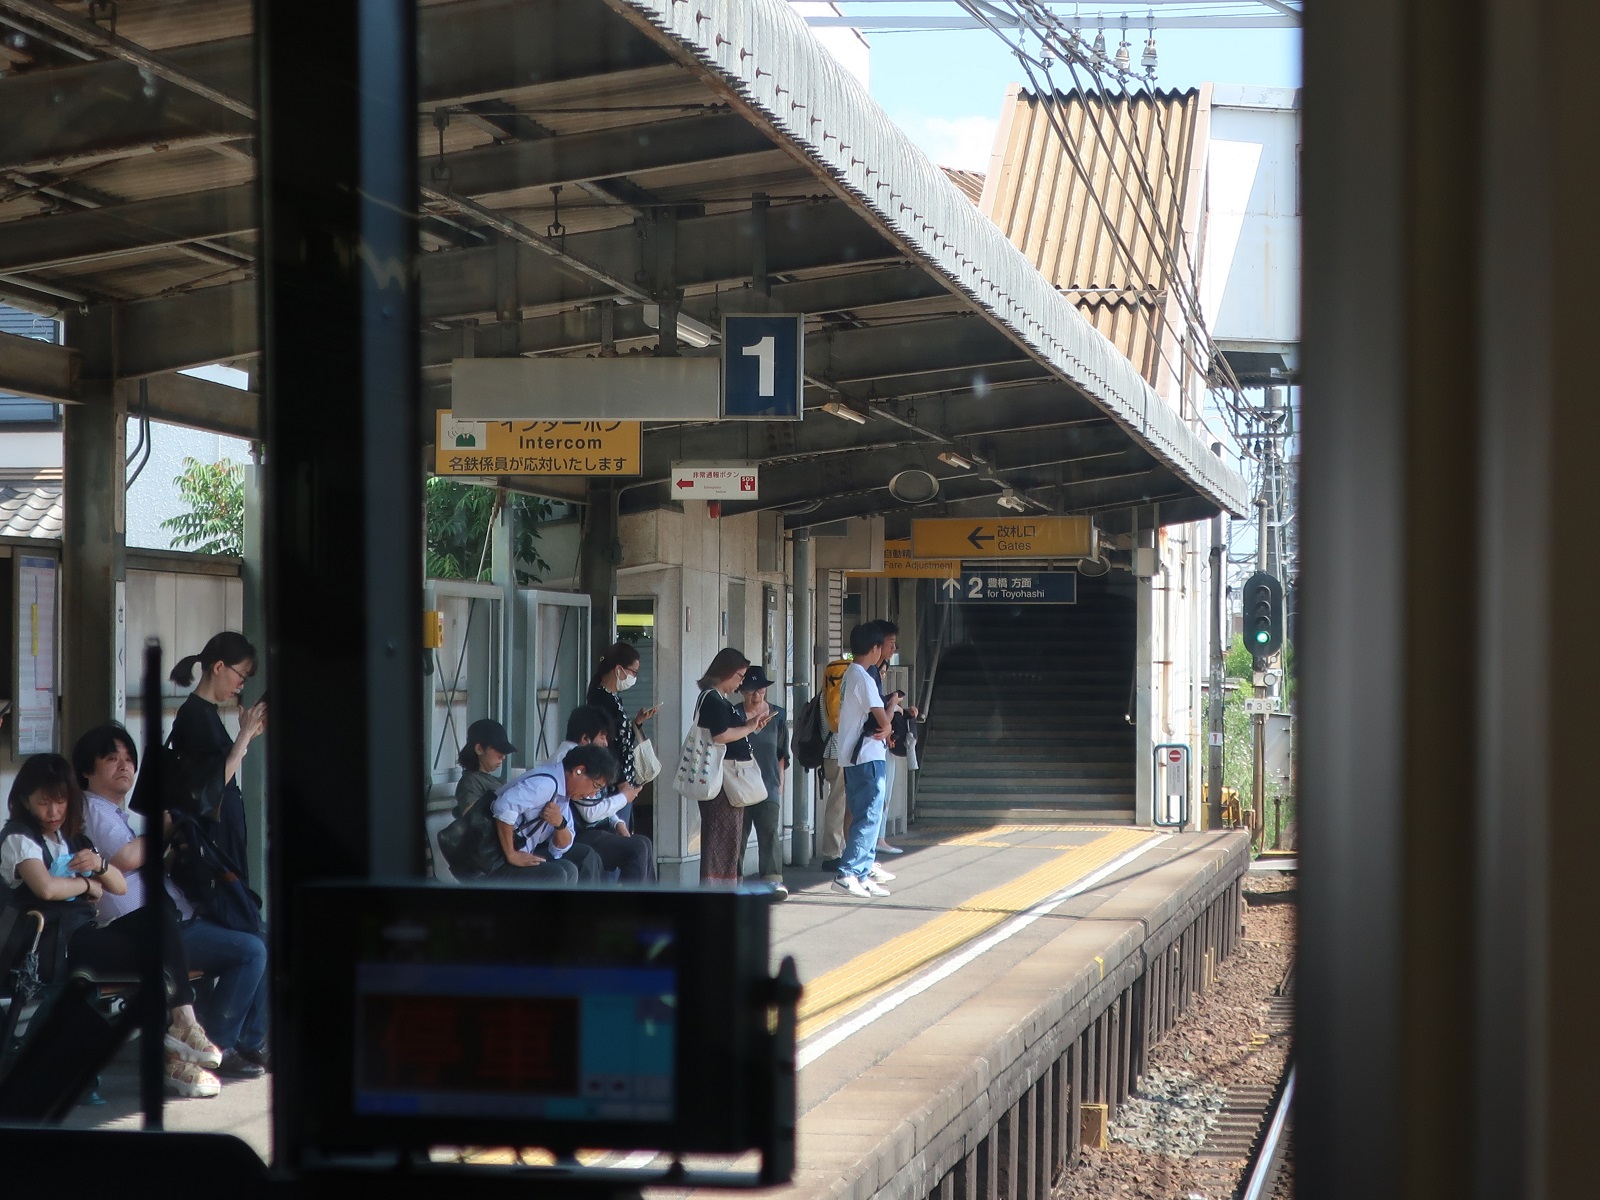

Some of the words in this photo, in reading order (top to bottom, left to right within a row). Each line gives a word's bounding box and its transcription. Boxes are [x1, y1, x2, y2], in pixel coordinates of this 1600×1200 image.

[742, 336, 775, 397] 1
[519, 436, 602, 449] Intercom
[449, 456, 627, 472] 名鉄係員が応対いたします
[997, 525, 1036, 538] 改札口
[998, 540, 1032, 551] Gates
[884, 561, 903, 569] Fare
[905, 561, 953, 570] Adjustment
[968, 577, 983, 598] 2
[987, 577, 1008, 588] 豊橋
[1011, 577, 1032, 588] 方面
[987, 589, 999, 598] for
[1001, 589, 1045, 600] Toyohashi
[1212, 733, 1218, 744] 1
